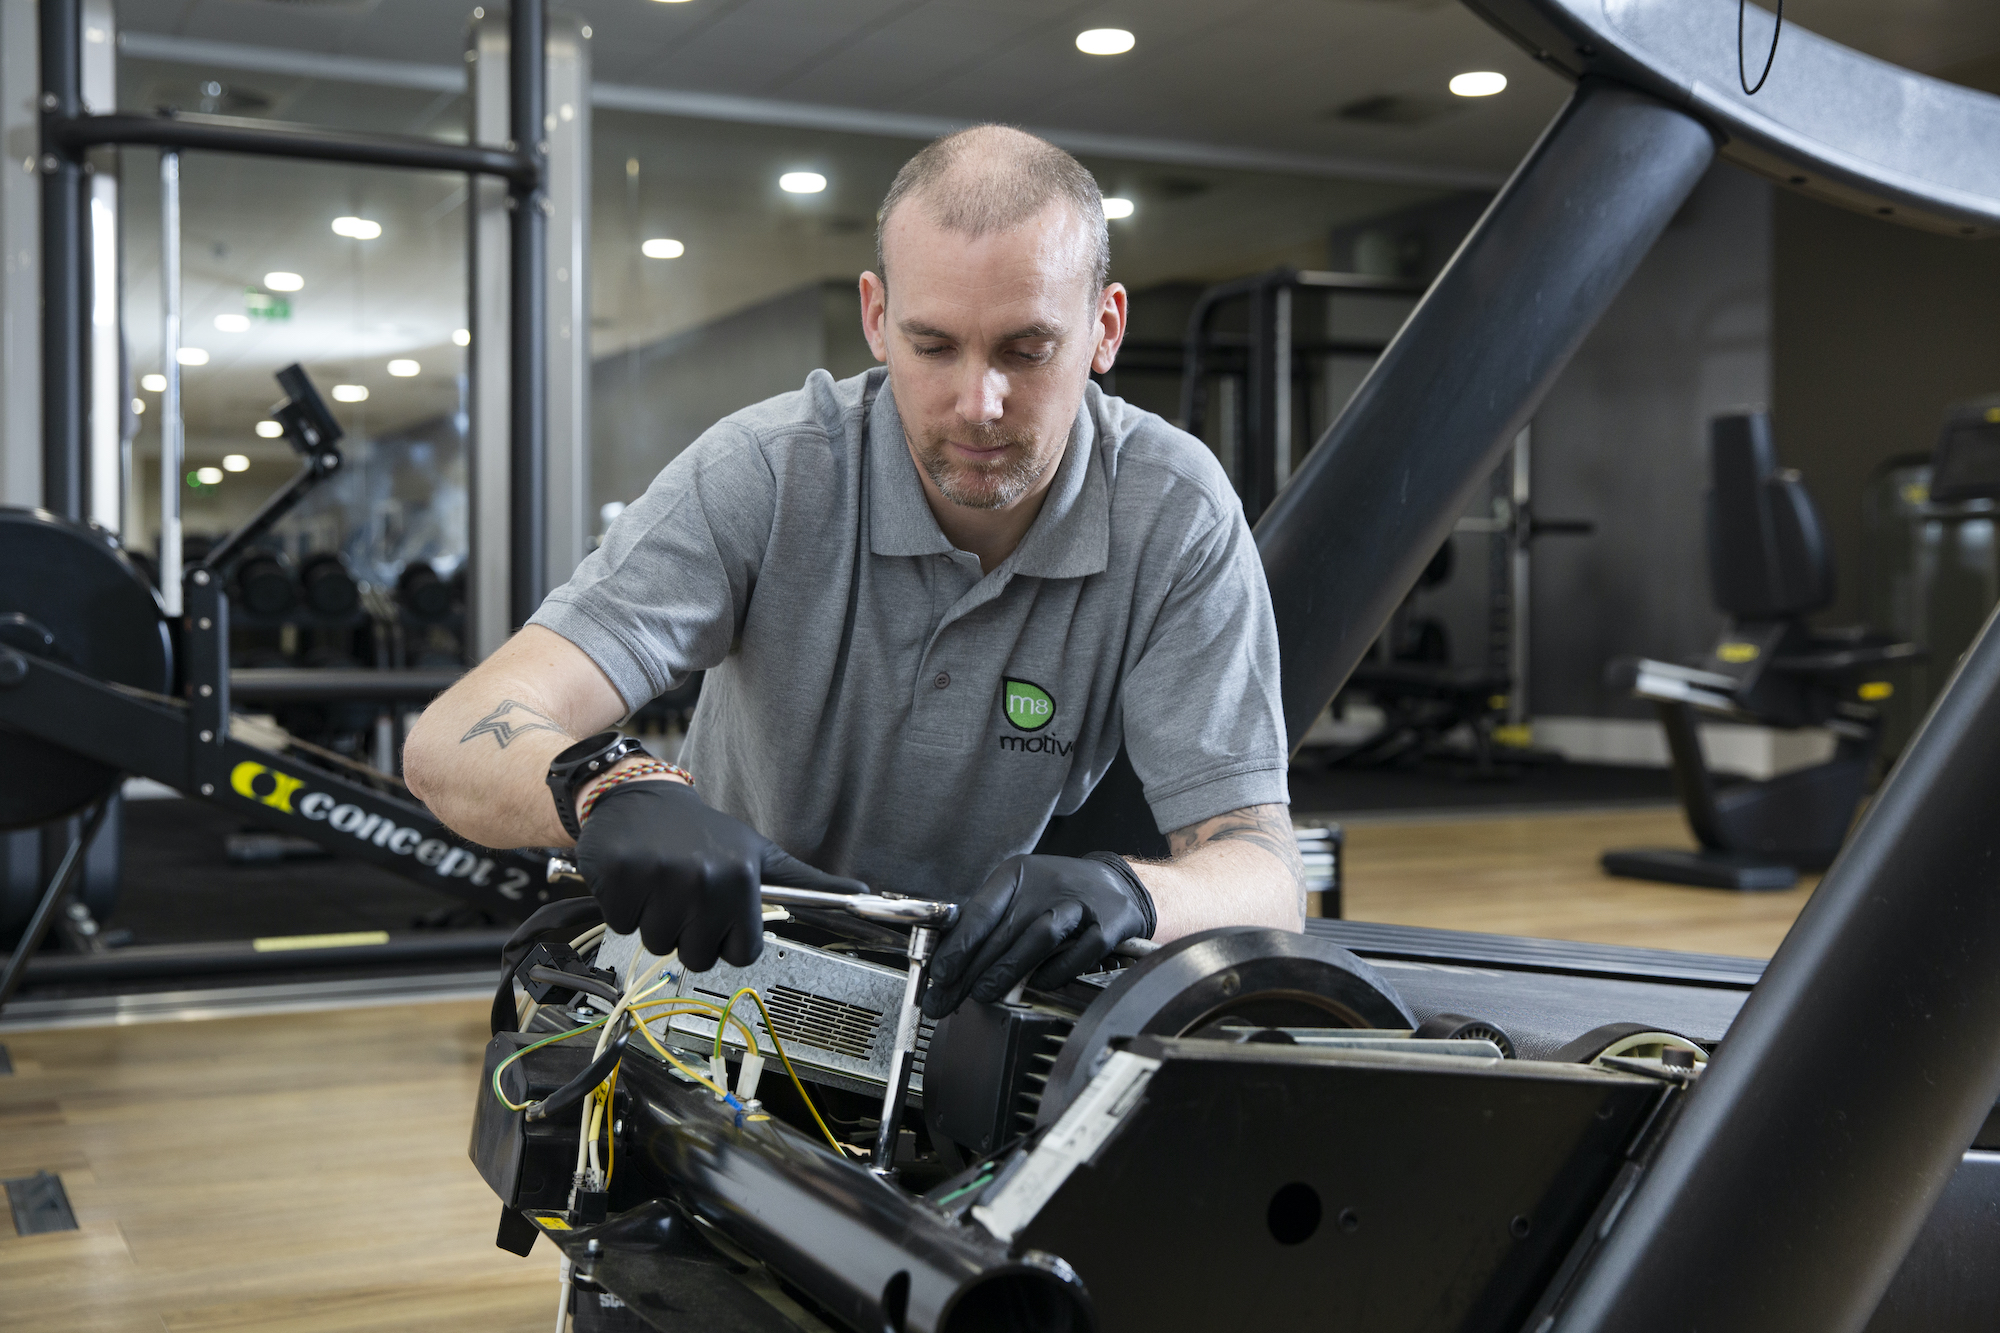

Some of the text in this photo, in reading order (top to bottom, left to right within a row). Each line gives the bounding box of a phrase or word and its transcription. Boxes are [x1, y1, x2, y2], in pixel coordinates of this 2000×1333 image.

[1009, 694, 1049, 715] m8
[1000, 732, 1073, 757] motiv
[300, 792, 531, 900] concept 2
